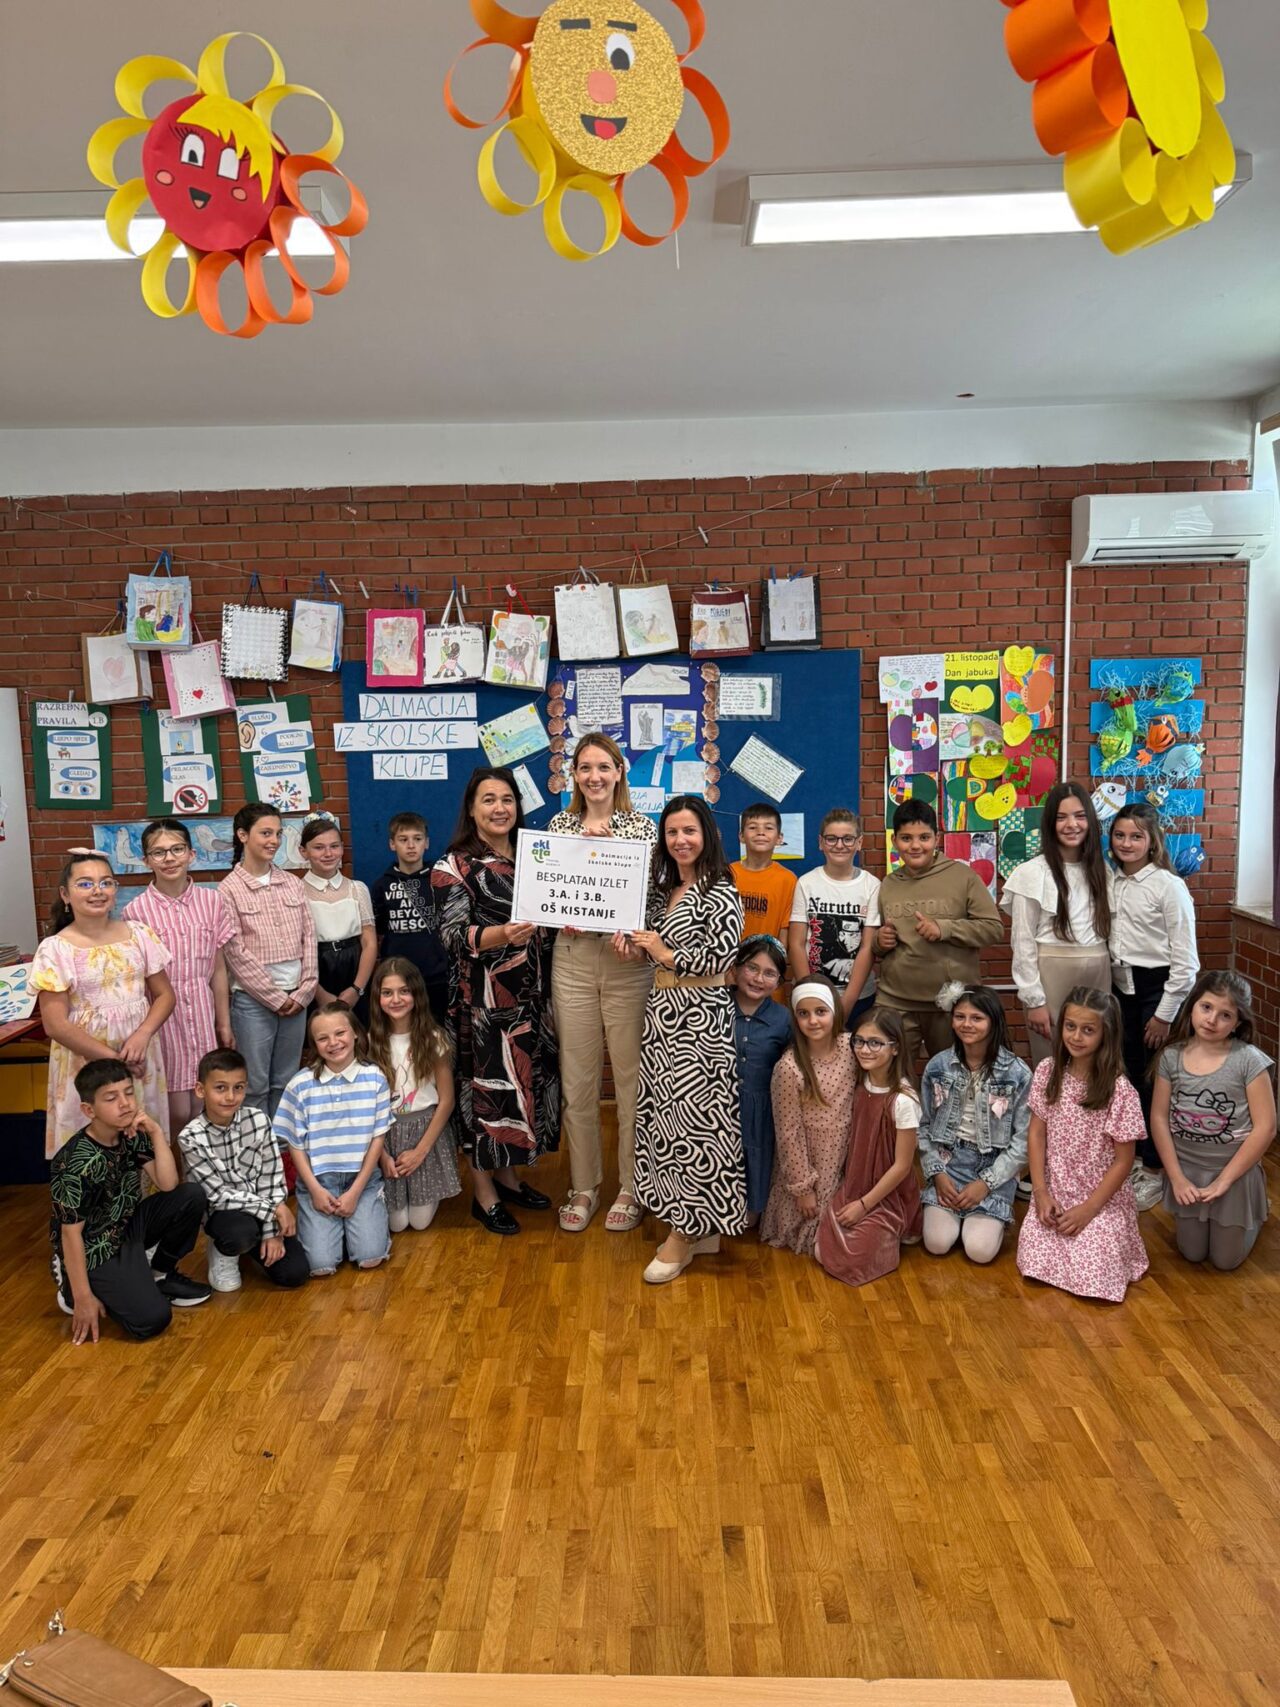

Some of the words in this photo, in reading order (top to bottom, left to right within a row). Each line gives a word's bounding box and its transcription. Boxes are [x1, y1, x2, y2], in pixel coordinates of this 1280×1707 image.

[945, 654, 958, 662] 21.
[961, 653, 999, 662] listopada
[945, 669, 961, 677] Dan
[966, 669, 994, 678] jabuka
[36, 703, 87, 711] RAZREDNA
[363, 695, 470, 719] DALMACIJA
[36, 717, 77, 725] PRAVILA
[336, 726, 354, 749] IZ
[366, 722, 460, 748] ŠKOLSKE
[378, 753, 445, 778] KLUPE
[536, 871, 596, 887] BESPLATAN
[599, 878, 629, 889] IZLET
[549, 888, 571, 900] 3.A.
[575, 890, 579, 901] i
[583, 891, 606, 903] 3.B.
[541, 901, 556, 913] OŠ
[561, 905, 616, 919] KISTANJE
[807, 896, 861, 915] Naruto
